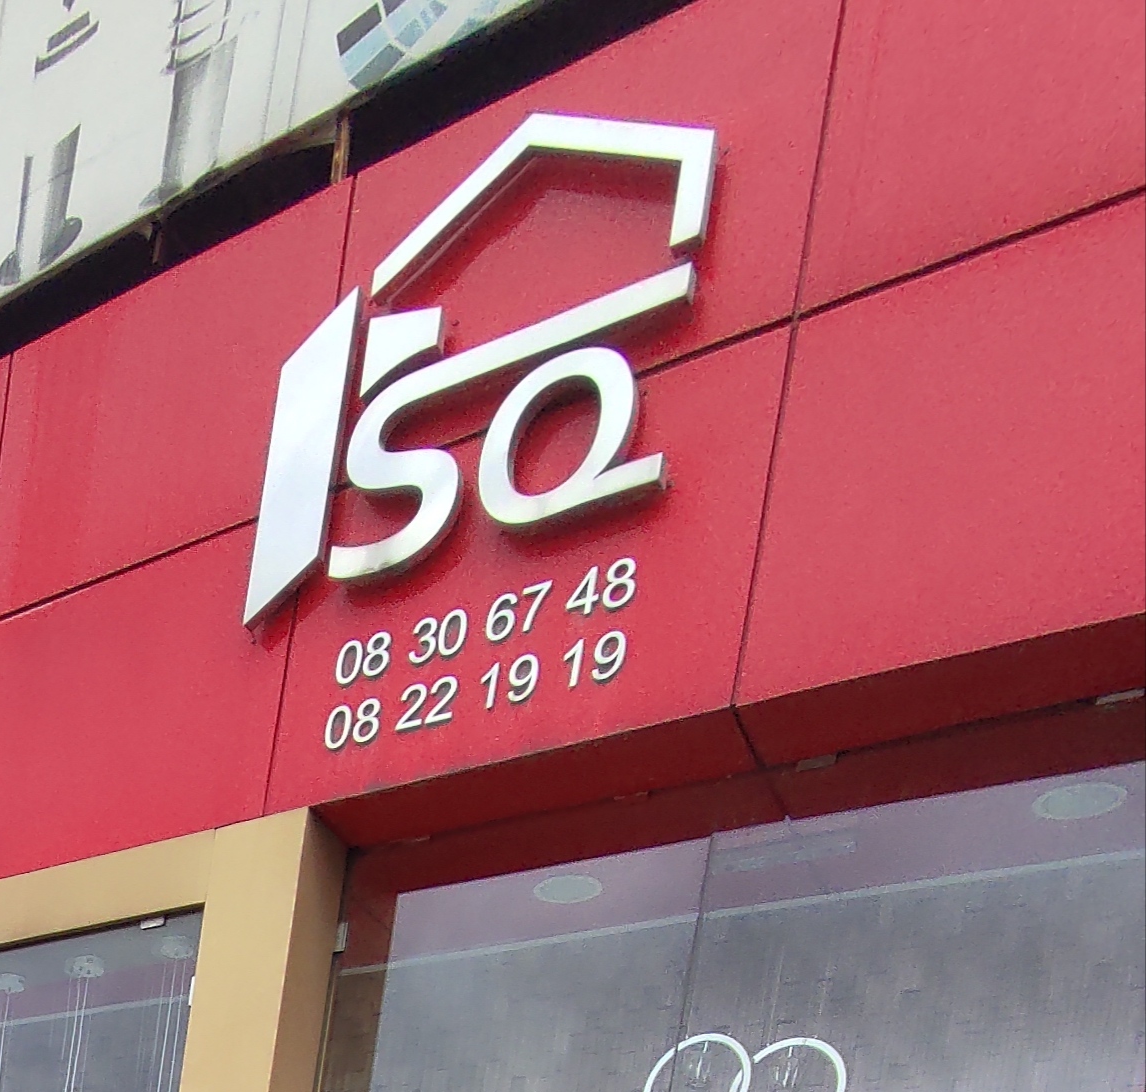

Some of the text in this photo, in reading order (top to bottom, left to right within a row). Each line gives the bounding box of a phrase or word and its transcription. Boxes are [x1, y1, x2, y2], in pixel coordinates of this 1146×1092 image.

[335, 557, 637, 687] 08 30 67 48
[324, 630, 628, 751] 08 22 19 19
